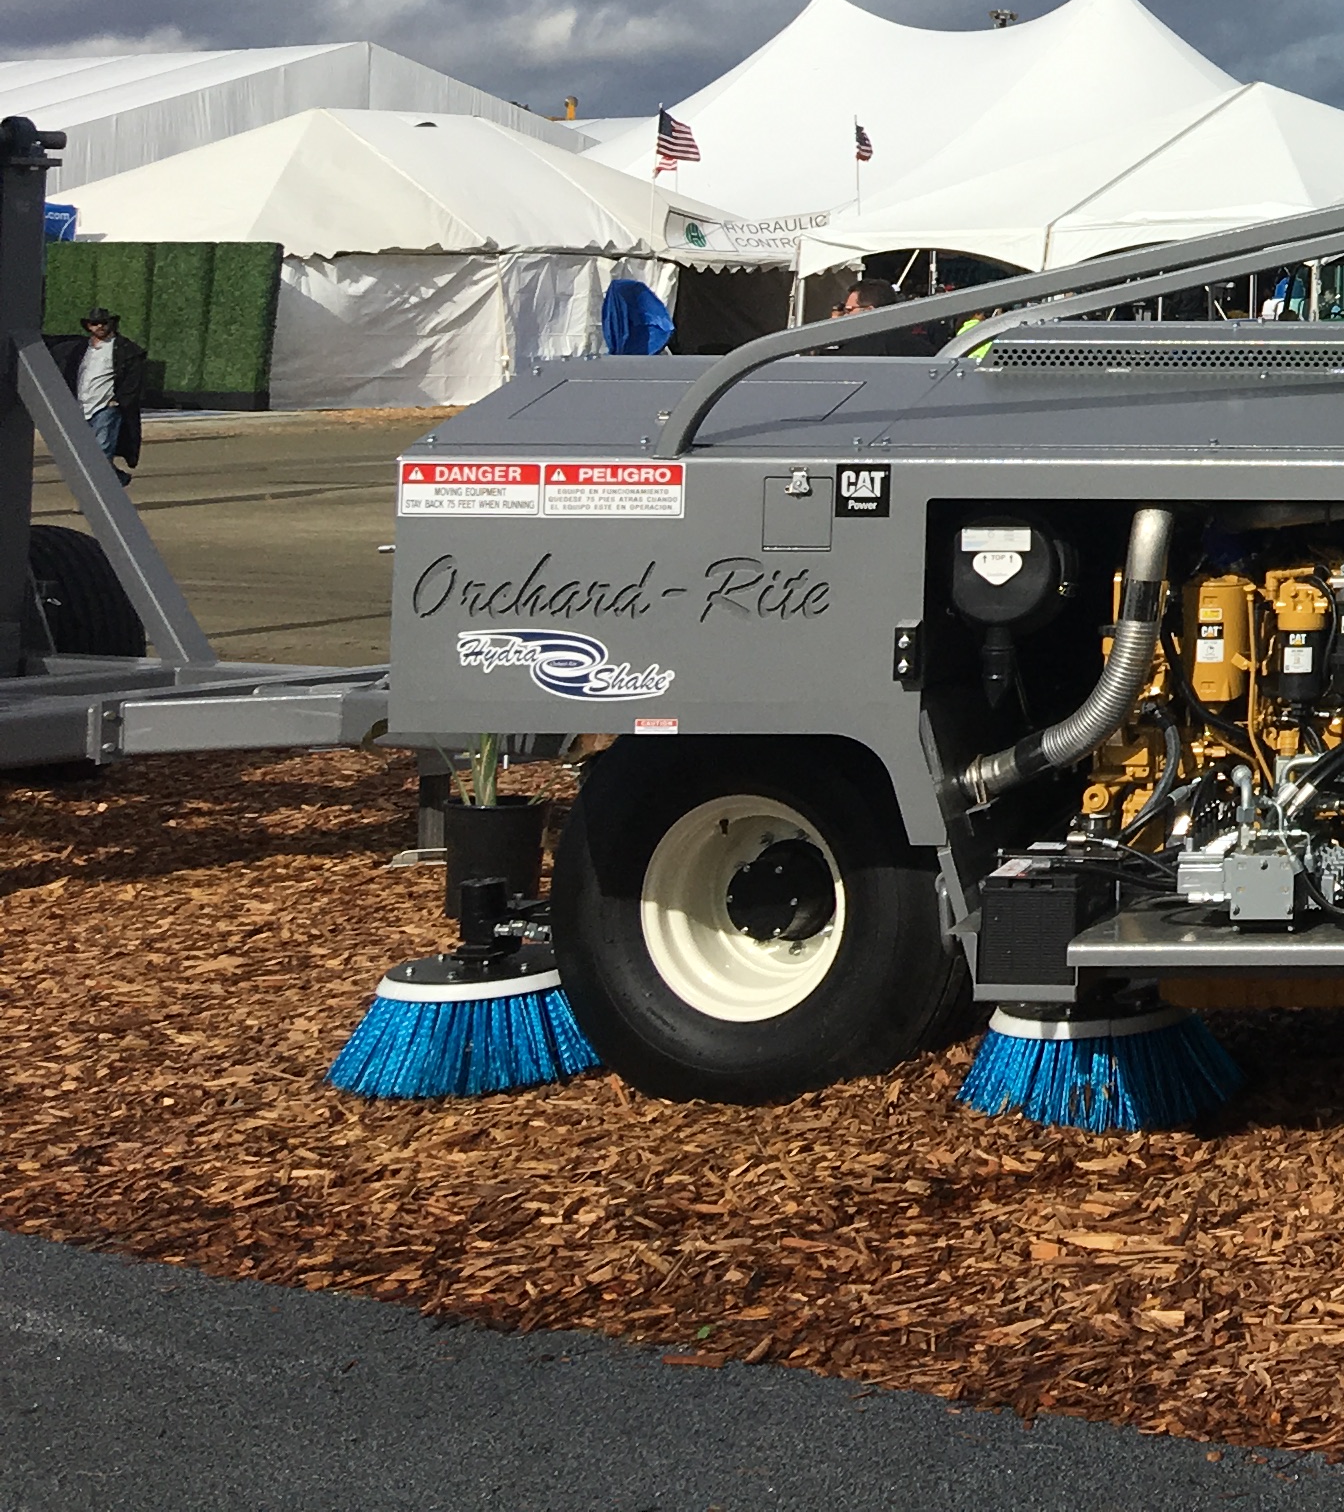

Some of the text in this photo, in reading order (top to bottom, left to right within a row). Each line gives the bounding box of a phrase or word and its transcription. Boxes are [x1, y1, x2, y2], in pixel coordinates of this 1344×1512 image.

[725, 214, 828, 235] HYDRAULIC
[435, 466, 522, 482] DANGER
[578, 468, 672, 483] PELIGRO
[434, 487, 507, 496] MOVING EQUIPMENT
[841, 470, 886, 498] CAT
[405, 499, 535, 509] STAY BACK 75 FEET WHEN RUNNING
[847, 500, 878, 510] Power
[1200, 625, 1219, 638] CAT
[1289, 633, 1307, 645] CAT
[459, 637, 541, 672] Hydra
[589, 666, 669, 693] Shake
